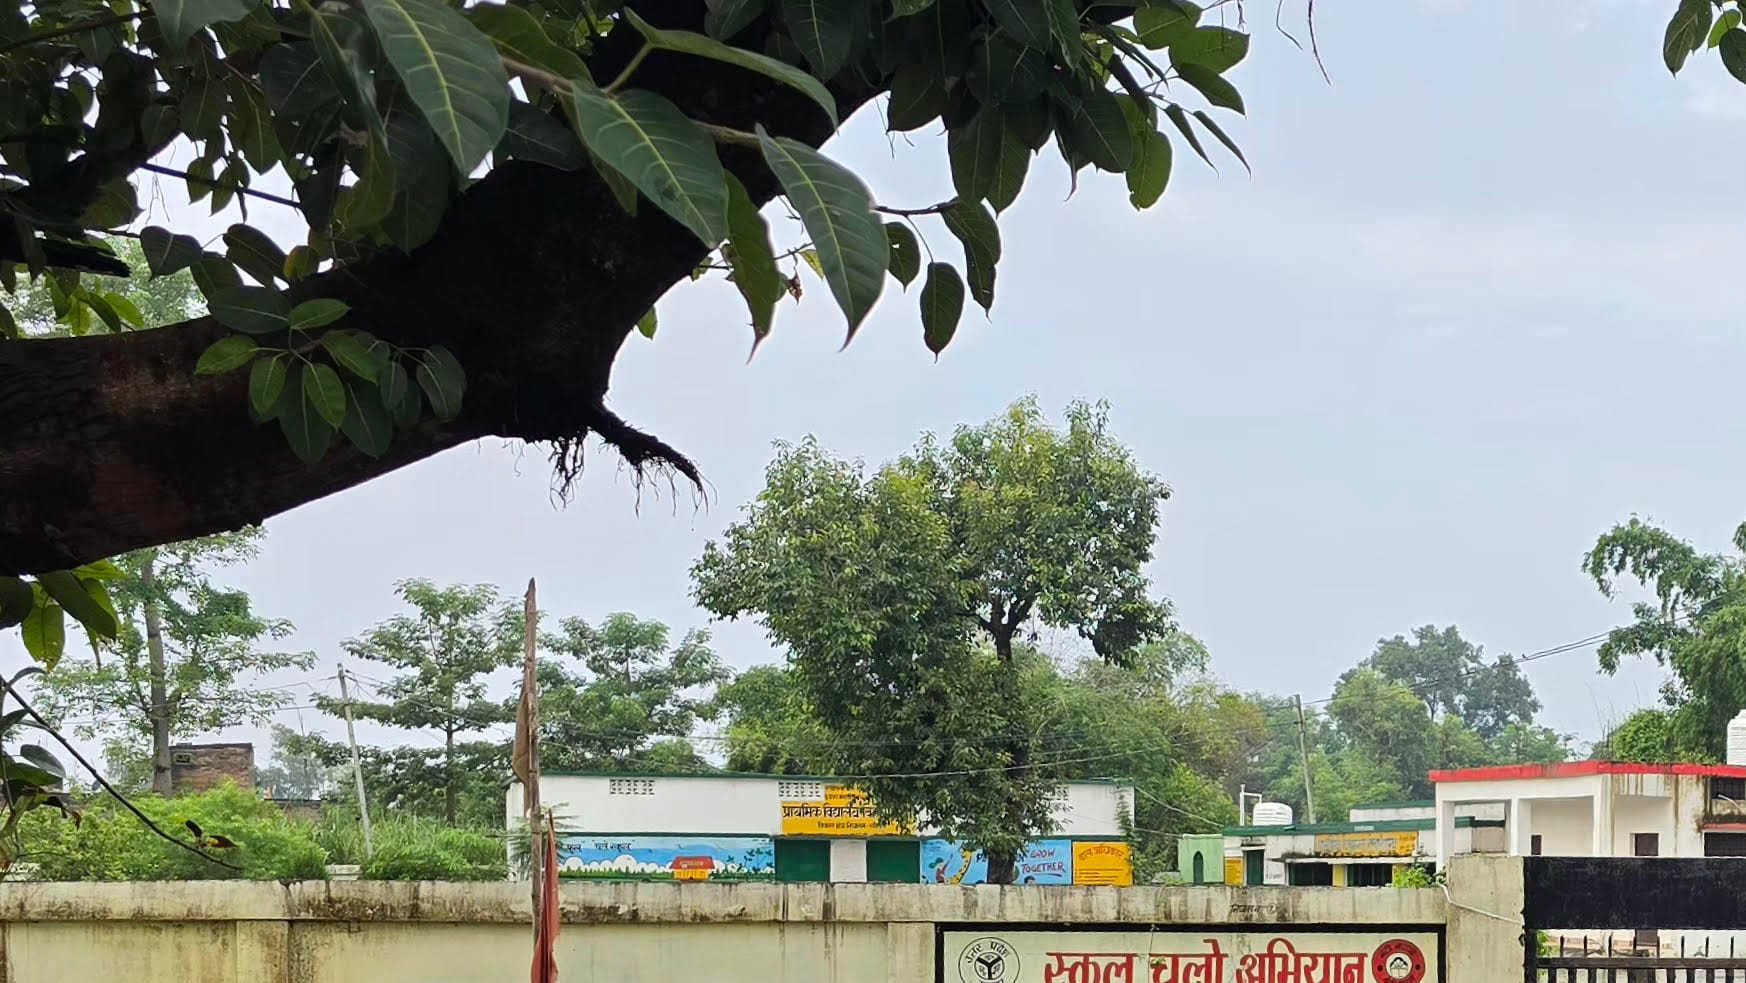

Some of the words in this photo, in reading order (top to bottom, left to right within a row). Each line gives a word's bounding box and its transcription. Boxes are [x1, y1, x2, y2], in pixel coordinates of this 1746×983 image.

[782, 803, 822, 818] प्राथमिक
[1030, 848, 1056, 858] GROW
[1021, 861, 1066, 874] TOGETHER
